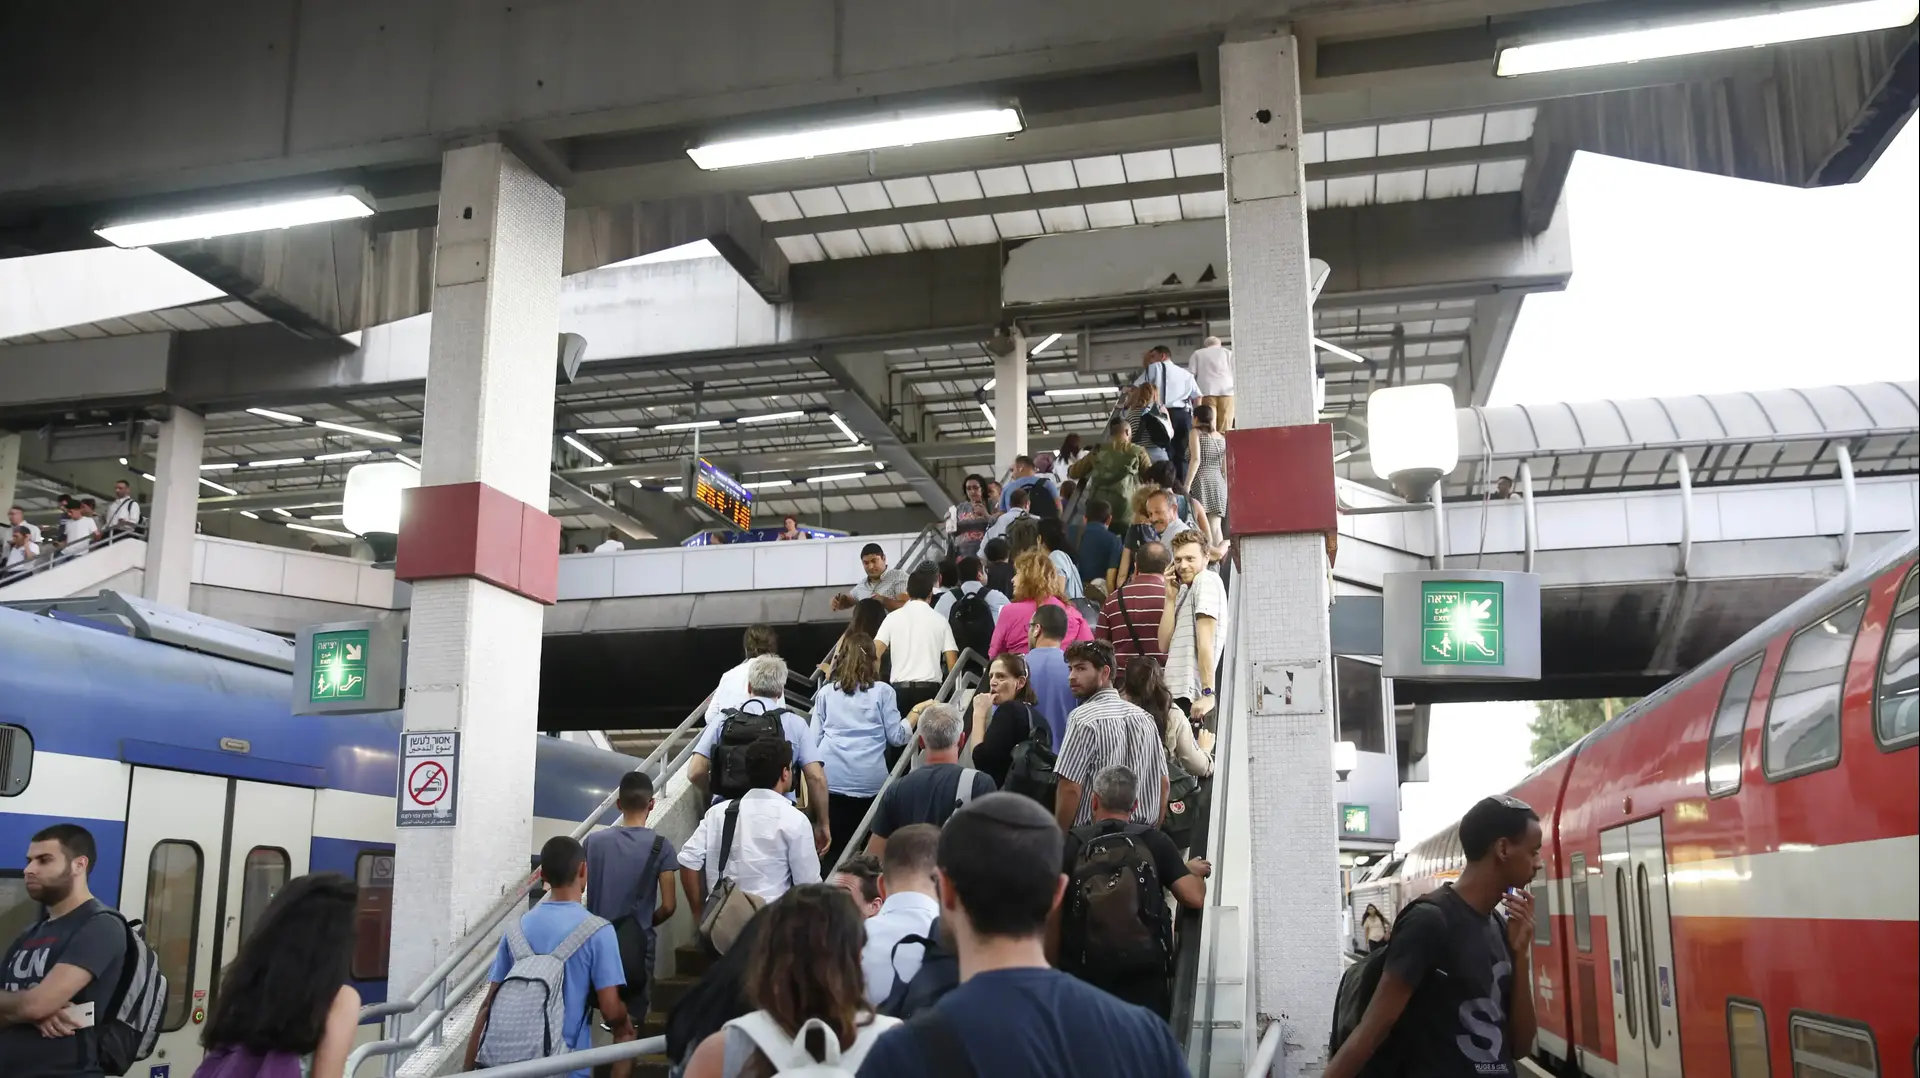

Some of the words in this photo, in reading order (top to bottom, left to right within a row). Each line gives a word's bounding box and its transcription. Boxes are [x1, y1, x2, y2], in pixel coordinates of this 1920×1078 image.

[1427, 594, 1458, 604] יציאה
[317, 641, 337, 650] יציאה
[410, 735, 430, 748] לעשן
[432, 736, 451, 745] אסור
